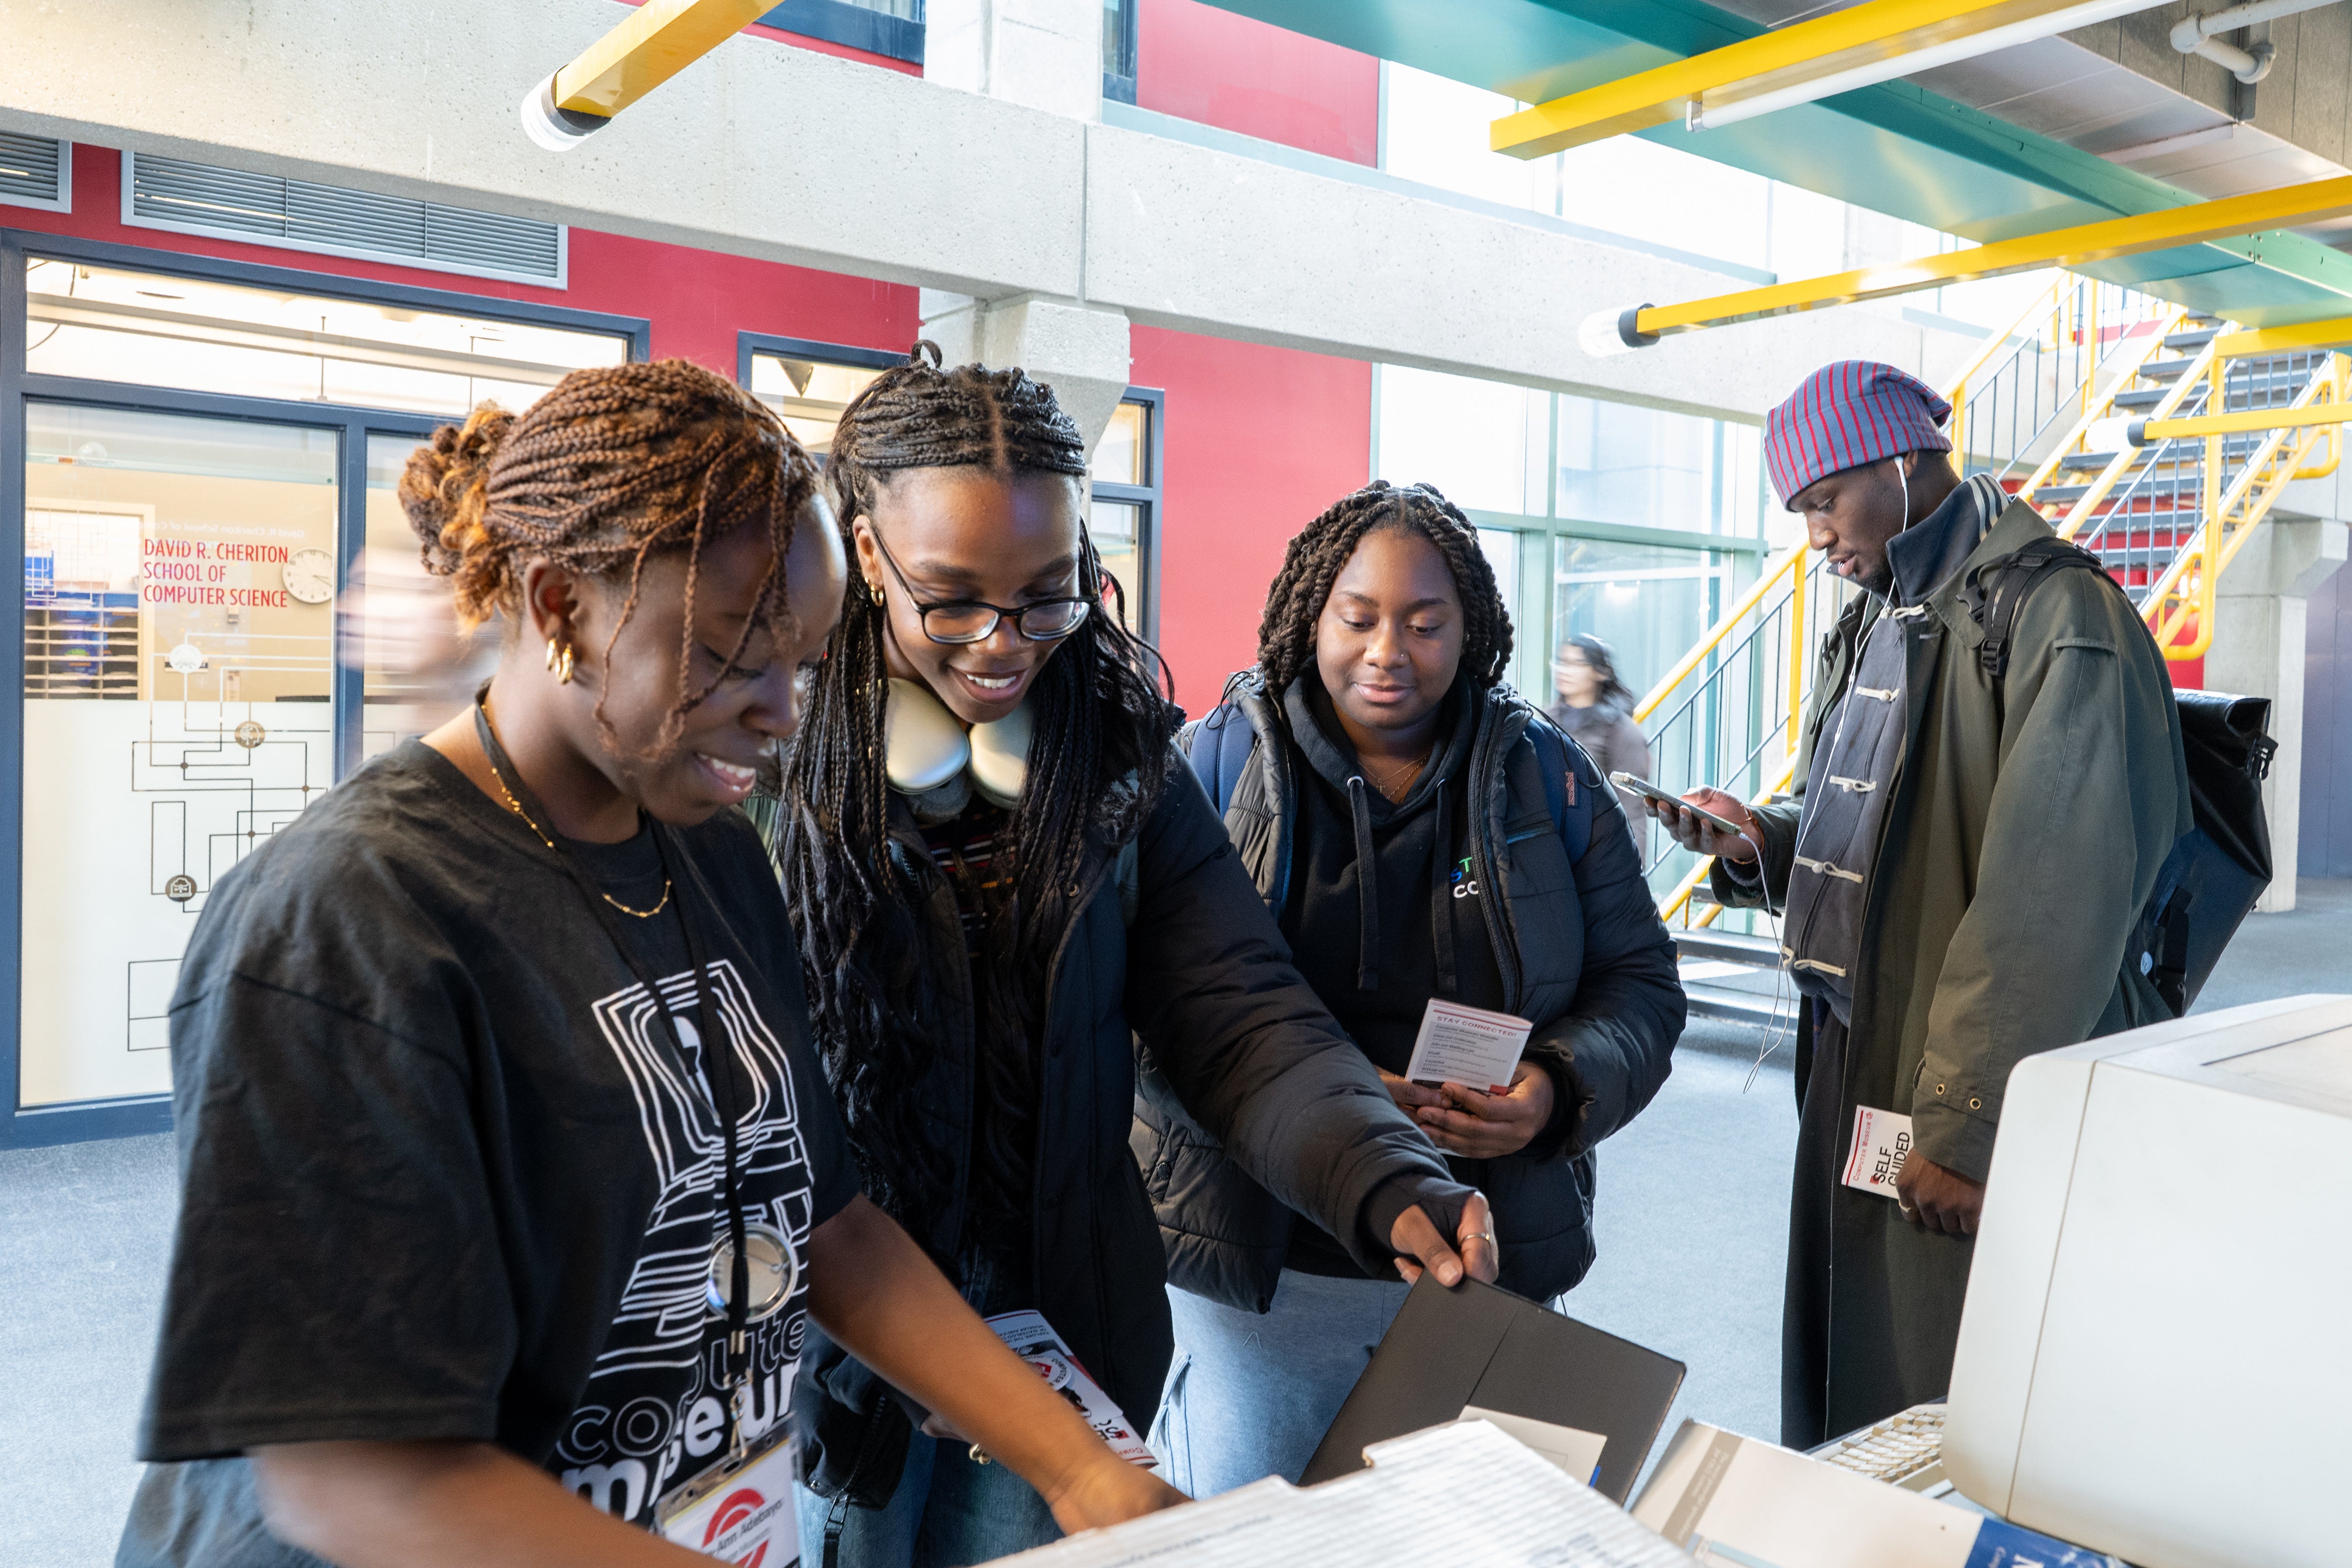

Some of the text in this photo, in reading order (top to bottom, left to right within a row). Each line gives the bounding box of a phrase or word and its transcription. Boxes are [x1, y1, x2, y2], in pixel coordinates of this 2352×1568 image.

[145, 539, 191, 558] DAVID
[197, 542, 211, 559] R.
[217, 543, 288, 563] CHERITON
[144, 562, 226, 582] SCHOOL OF
[144, 585, 288, 608] COMPUTER SCIENCE
[1436, 1016, 1459, 1024] STAY
[1462, 1020, 1517, 1037] CONNECTED!
[1853, 1149, 1867, 1181] COMPUTER
[1873, 1146, 1891, 1183] SELF
